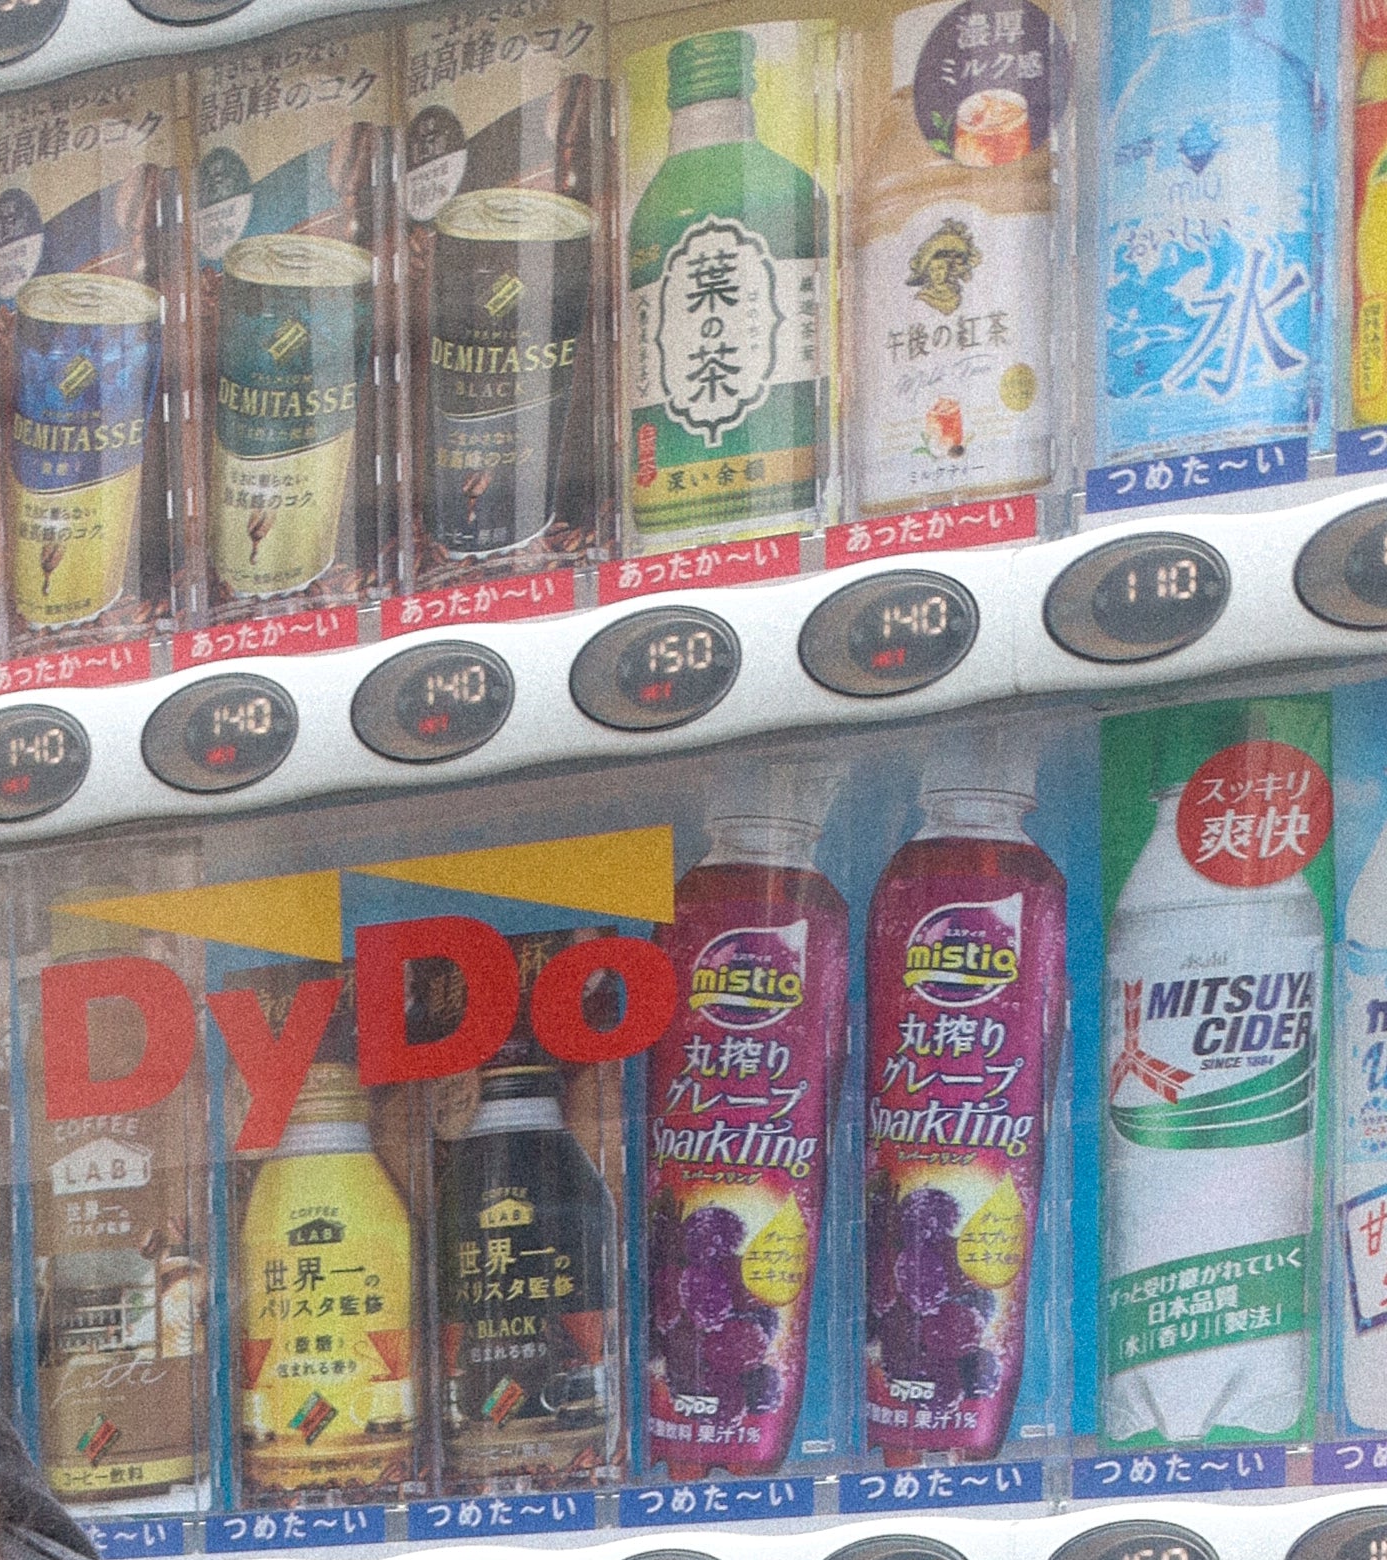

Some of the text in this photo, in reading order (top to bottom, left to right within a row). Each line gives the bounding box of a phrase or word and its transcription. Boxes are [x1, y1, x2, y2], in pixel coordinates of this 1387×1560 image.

[956, 14, 1026, 52] 濃厚
[408, 18, 595, 98] 最高峰のコク
[939, 47, 1047, 84] ミルク感
[198, 70, 378, 136] 最高峰のコク
[685, 249, 743, 404] 葉の茶
[886, 309, 1012, 361] 午後の紅茶
[1161, 246, 1312, 405] 水
[430, 338, 576, 372] DEMITASSE
[218, 381, 358, 416] DEMITASSE
[13, 417, 145, 450] DEMITASSE
[909, 463, 987, 484] ミルクティー
[1126, 560, 1199, 602] 110
[881, 596, 946, 637] 140
[647, 633, 713, 672] 150
[425, 665, 486, 705] 140
[211, 697, 269, 735] 140
[8, 730, 65, 766] 140
[1196, 771, 1310, 809] スッキリ
[1194, 810, 1311, 866] 爽快
[1146, 970, 1314, 1018] MITSUYA
[40, 914, 676, 1152] DyDo
[898, 1017, 1009, 1059] 丸搾り
[1193, 1013, 1313, 1057] CIDER
[683, 1039, 792, 1081] 丸搾り
[881, 1054, 1026, 1100] グレープ
[1198, 1056, 1244, 1074] SINCE
[665, 1077, 810, 1122] グレープ
[53, 1116, 140, 1143] COFFEE
[867, 1096, 1034, 1160] Sparkling
[651, 1118, 817, 1180] Sparkling
[65, 1159, 126, 1185] LAB
[478, 1184, 528, 1203] COFFEE
[289, 1205, 340, 1221] COFFEE
[485, 1209, 522, 1224] LAB
[294, 1229, 332, 1244] LAB
[263, 1256, 380, 1294] 世界一の
[457, 1237, 572, 1276] 世界一の
[455, 1274, 575, 1303] バリスタ監修
[1146, 1287, 1239, 1326] 日本品質
[258, 1294, 384, 1322] バリスタ監修
[476, 1317, 537, 1340] BLACK
[696, 1423, 762, 1445] 果汁1%
[913, 1405, 980, 1429] 果汁1%
[61, 1465, 144, 1489] コーヒー飲料
